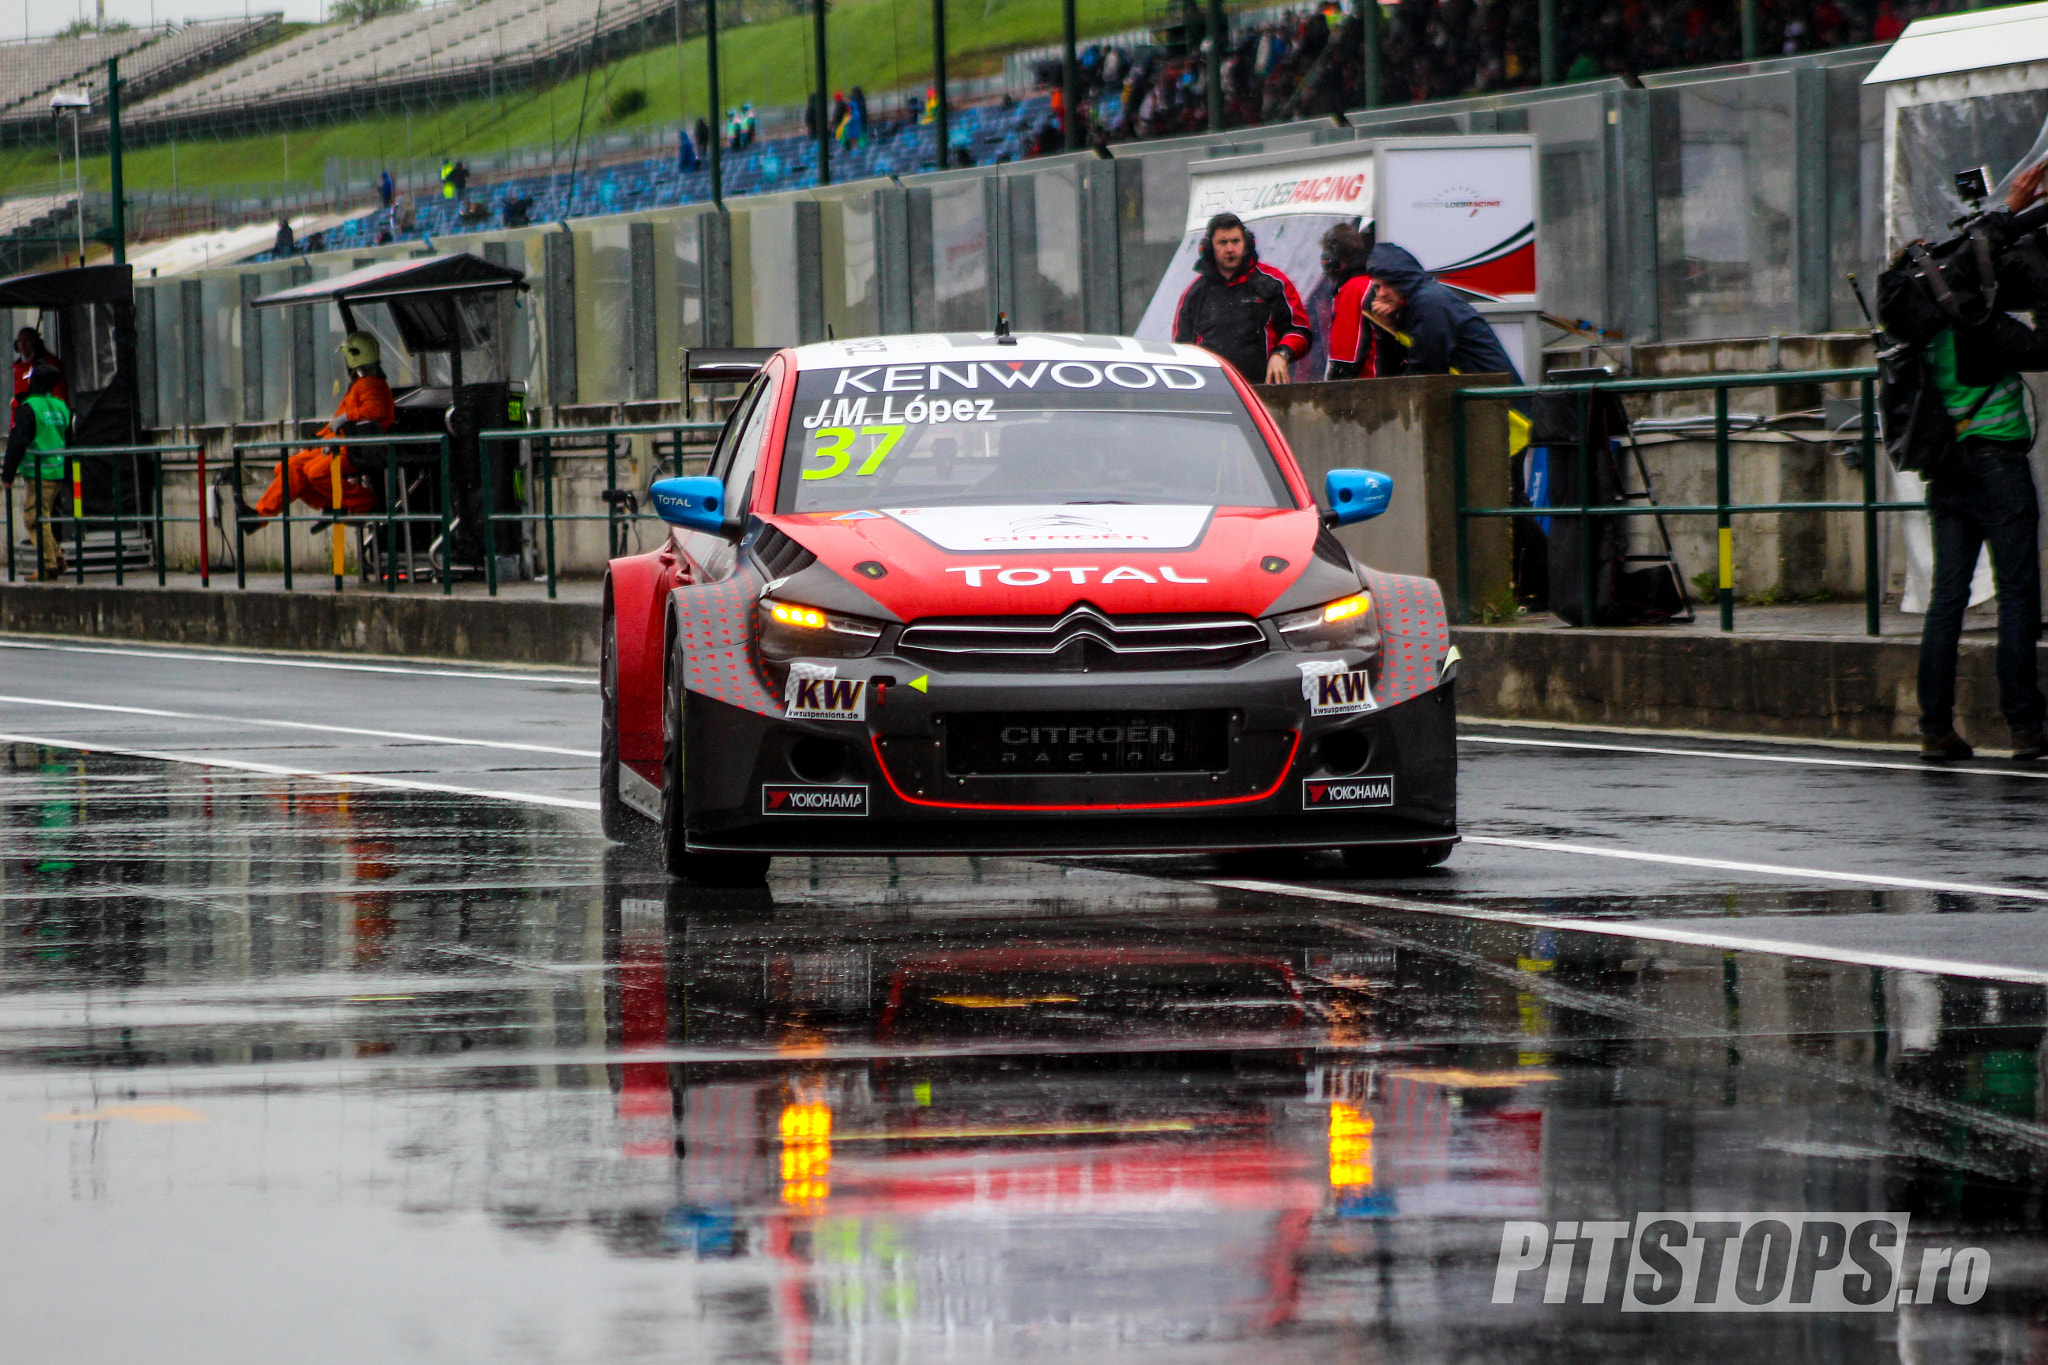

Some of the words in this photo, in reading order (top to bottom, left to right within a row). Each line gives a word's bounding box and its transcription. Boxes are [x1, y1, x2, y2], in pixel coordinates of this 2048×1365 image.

[834, 361, 1206, 395] KENWOOD
[803, 397, 872, 429] J.M.
[882, 394, 997, 424] López
[802, 425, 906, 480] 37
[657, 495, 691, 507] TOTAL
[945, 565, 1207, 588] TOTAL
[795, 679, 864, 711] KW
[1317, 671, 1367, 706] KW
[788, 710, 859, 720] kwsuspensions.de
[1313, 703, 1372, 715] kwsuspensions.de
[789, 793, 862, 808] YOKOHAMA
[1327, 784, 1390, 800] YOKOHAMA
